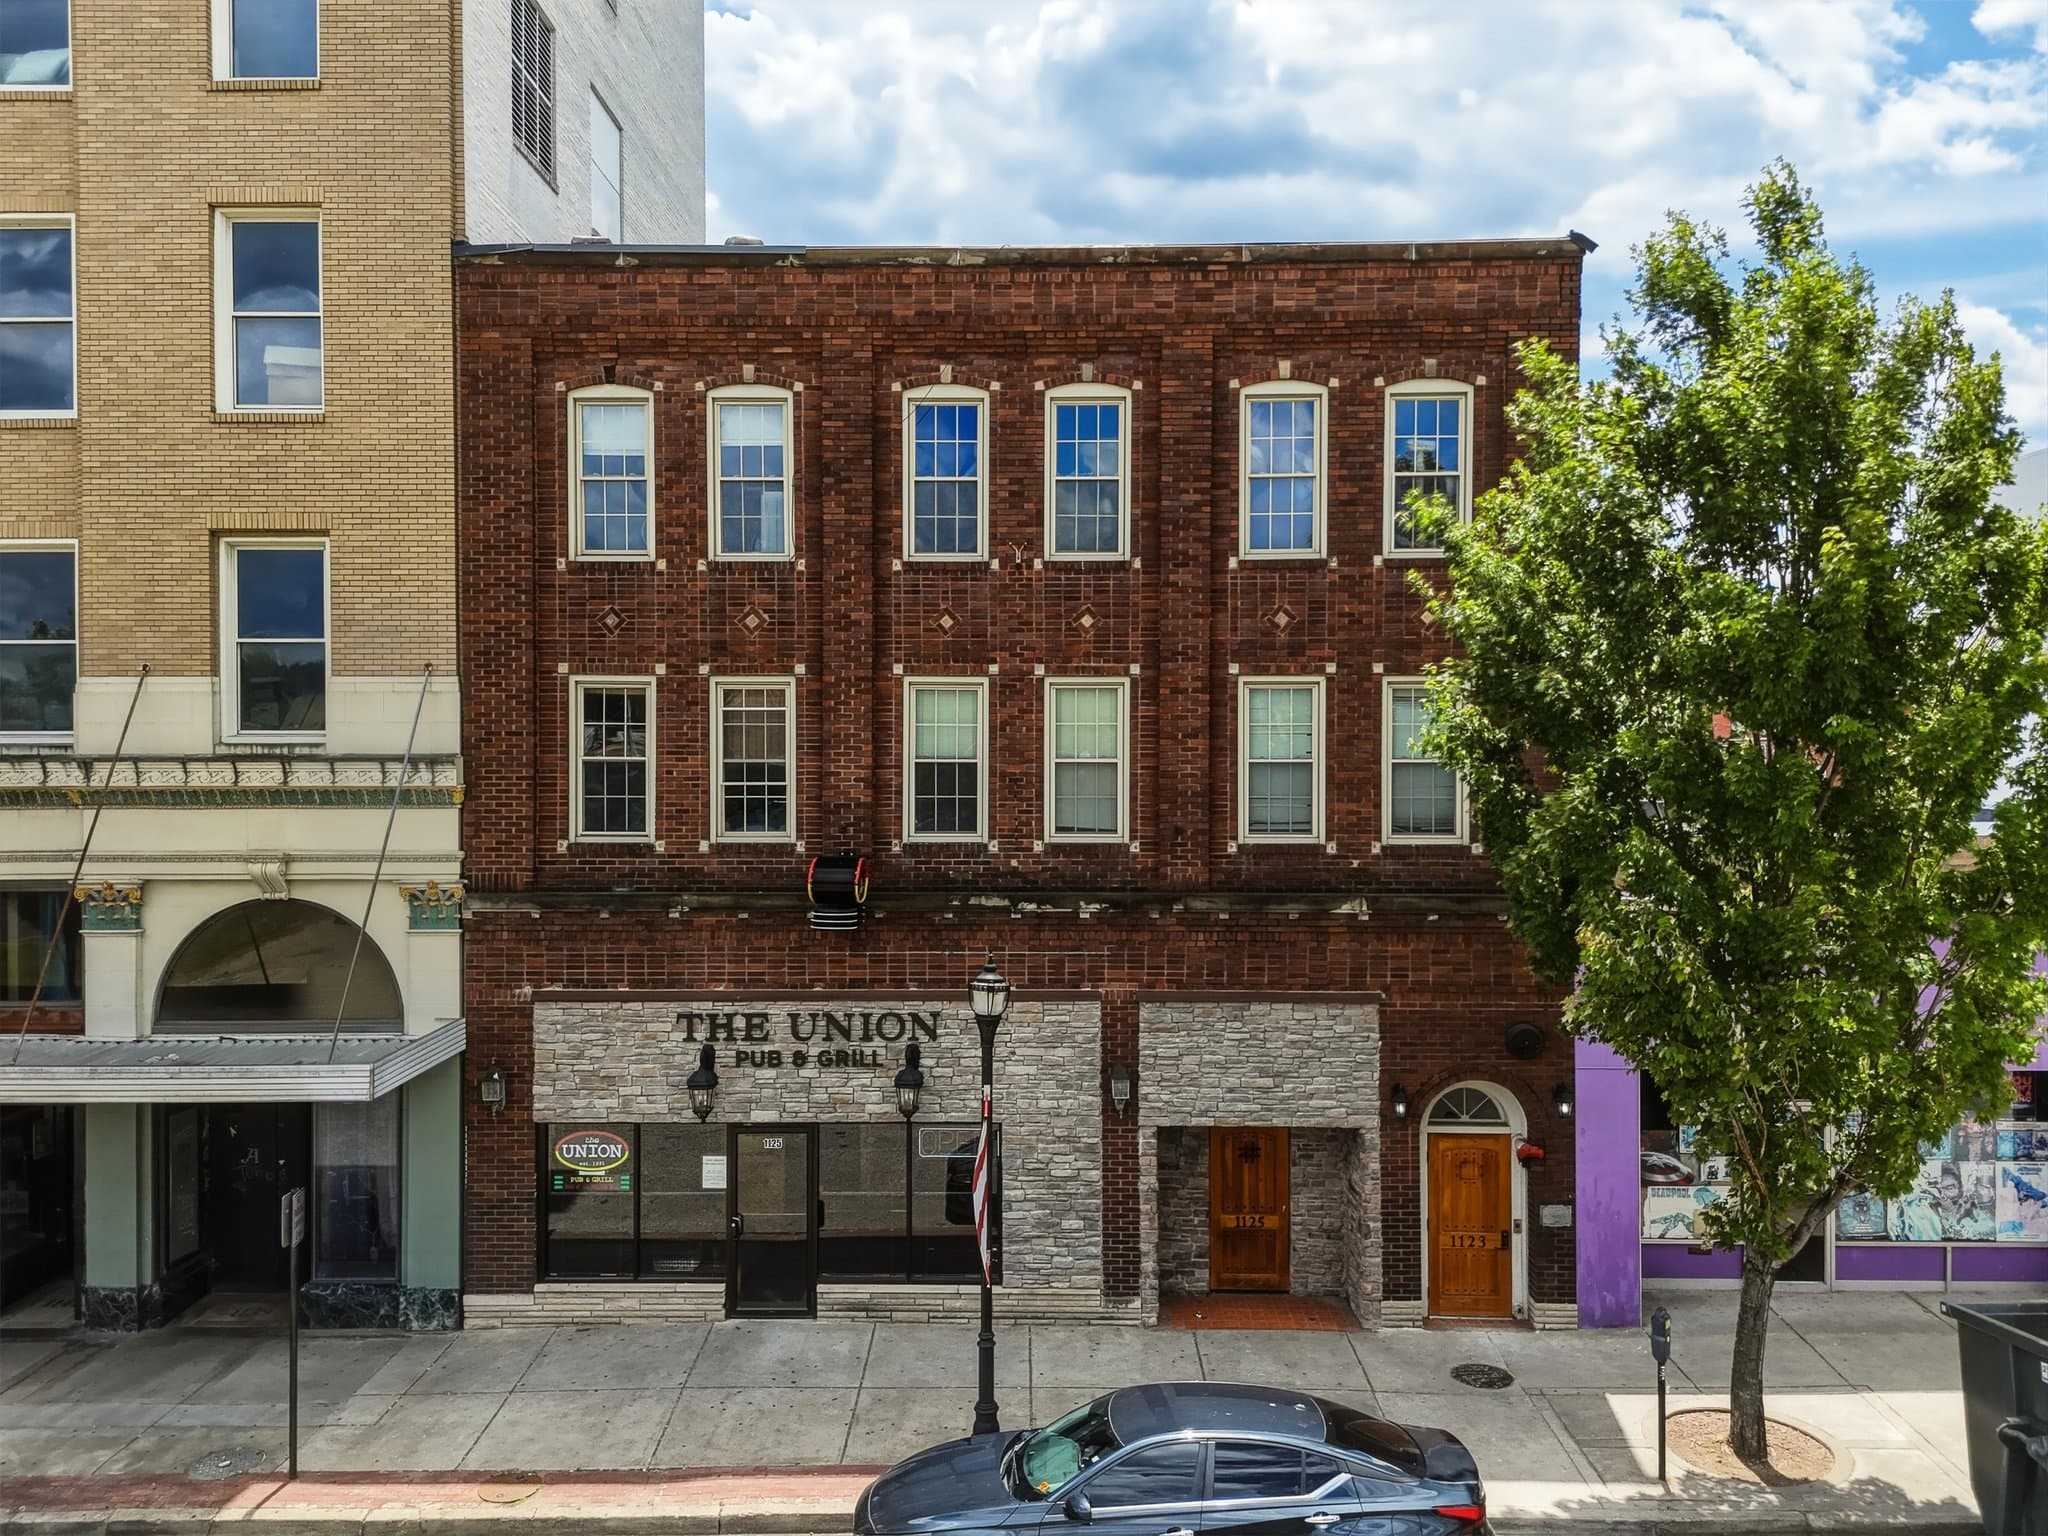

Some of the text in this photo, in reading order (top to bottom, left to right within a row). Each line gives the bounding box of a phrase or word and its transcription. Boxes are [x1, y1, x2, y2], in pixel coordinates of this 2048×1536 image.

[676, 1012, 940, 1042] THE UNION
[735, 1050, 883, 1068] PUB & GRILL
[763, 1138, 783, 1149] 1125
[921, 1130, 981, 1155] OPE
[561, 1144, 622, 1158] UNION
[1651, 1187, 1691, 1199] DEADPOOL
[1236, 1215, 1265, 1228] 1125
[1450, 1235, 1486, 1248] 1123
